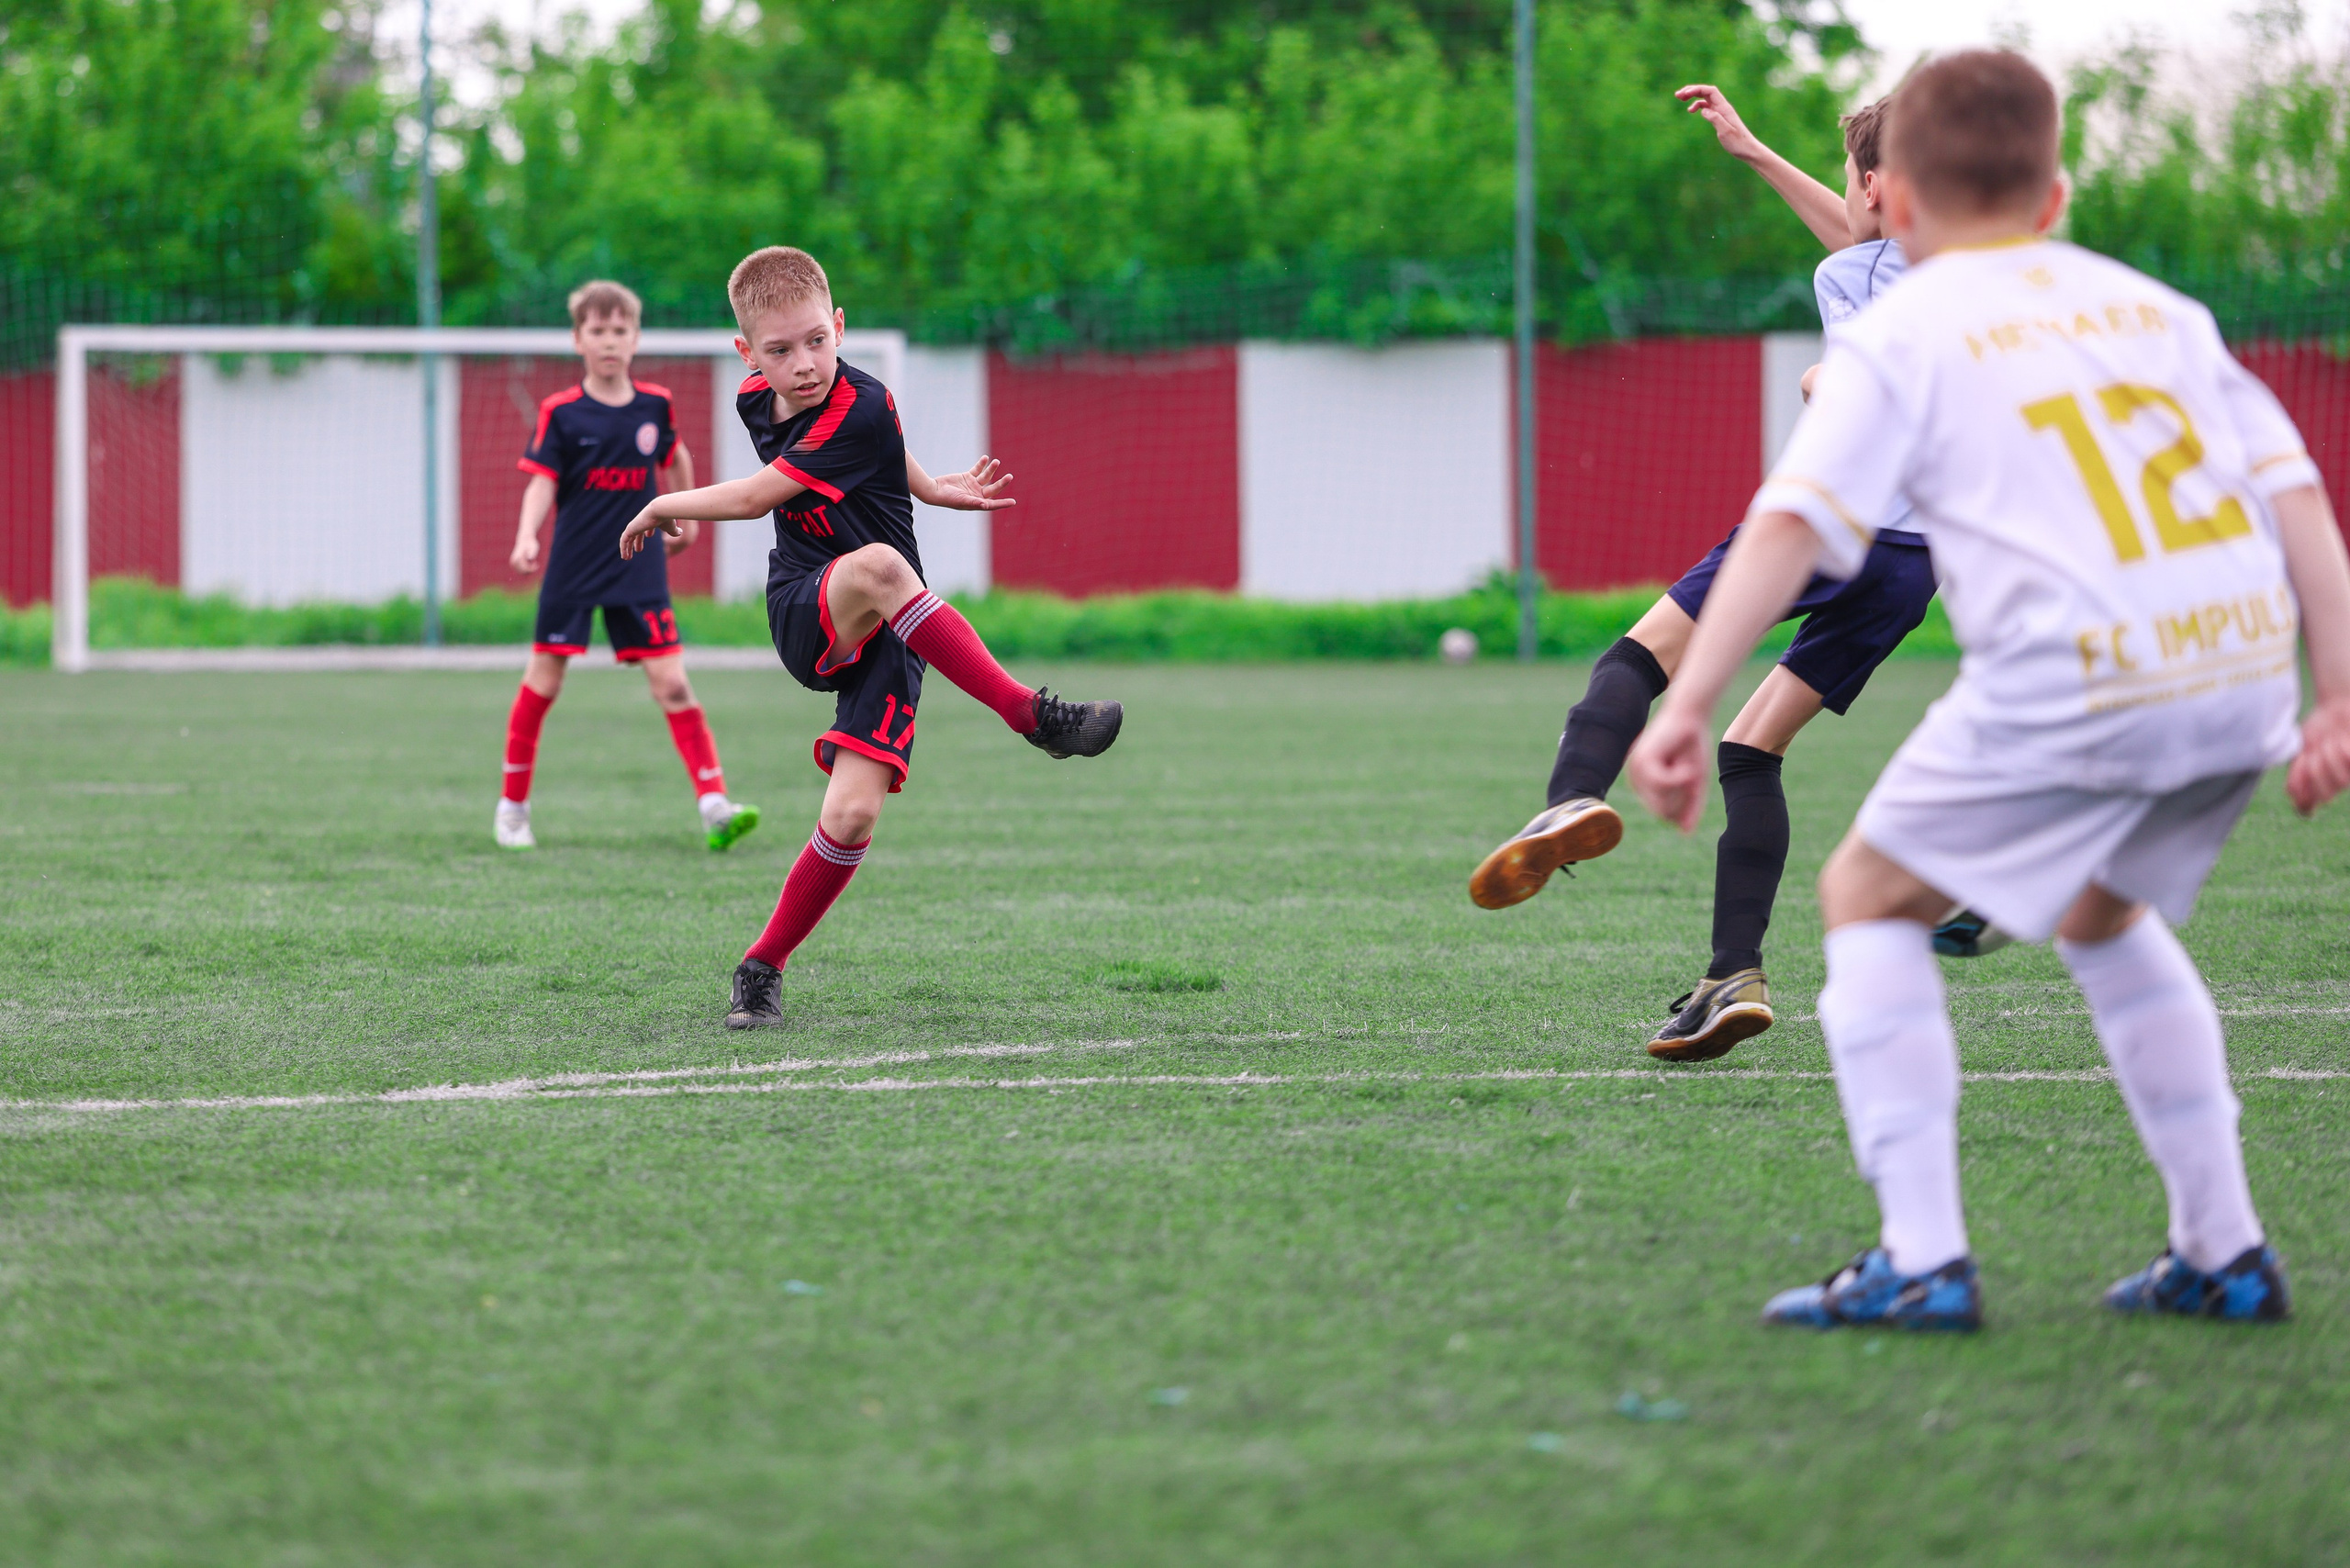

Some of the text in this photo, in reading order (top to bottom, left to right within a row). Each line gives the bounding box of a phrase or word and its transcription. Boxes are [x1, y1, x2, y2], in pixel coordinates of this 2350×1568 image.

[2019, 383, 2253, 564] 12
[2076, 623, 2137, 676] FC
[871, 693, 916, 751] 17
